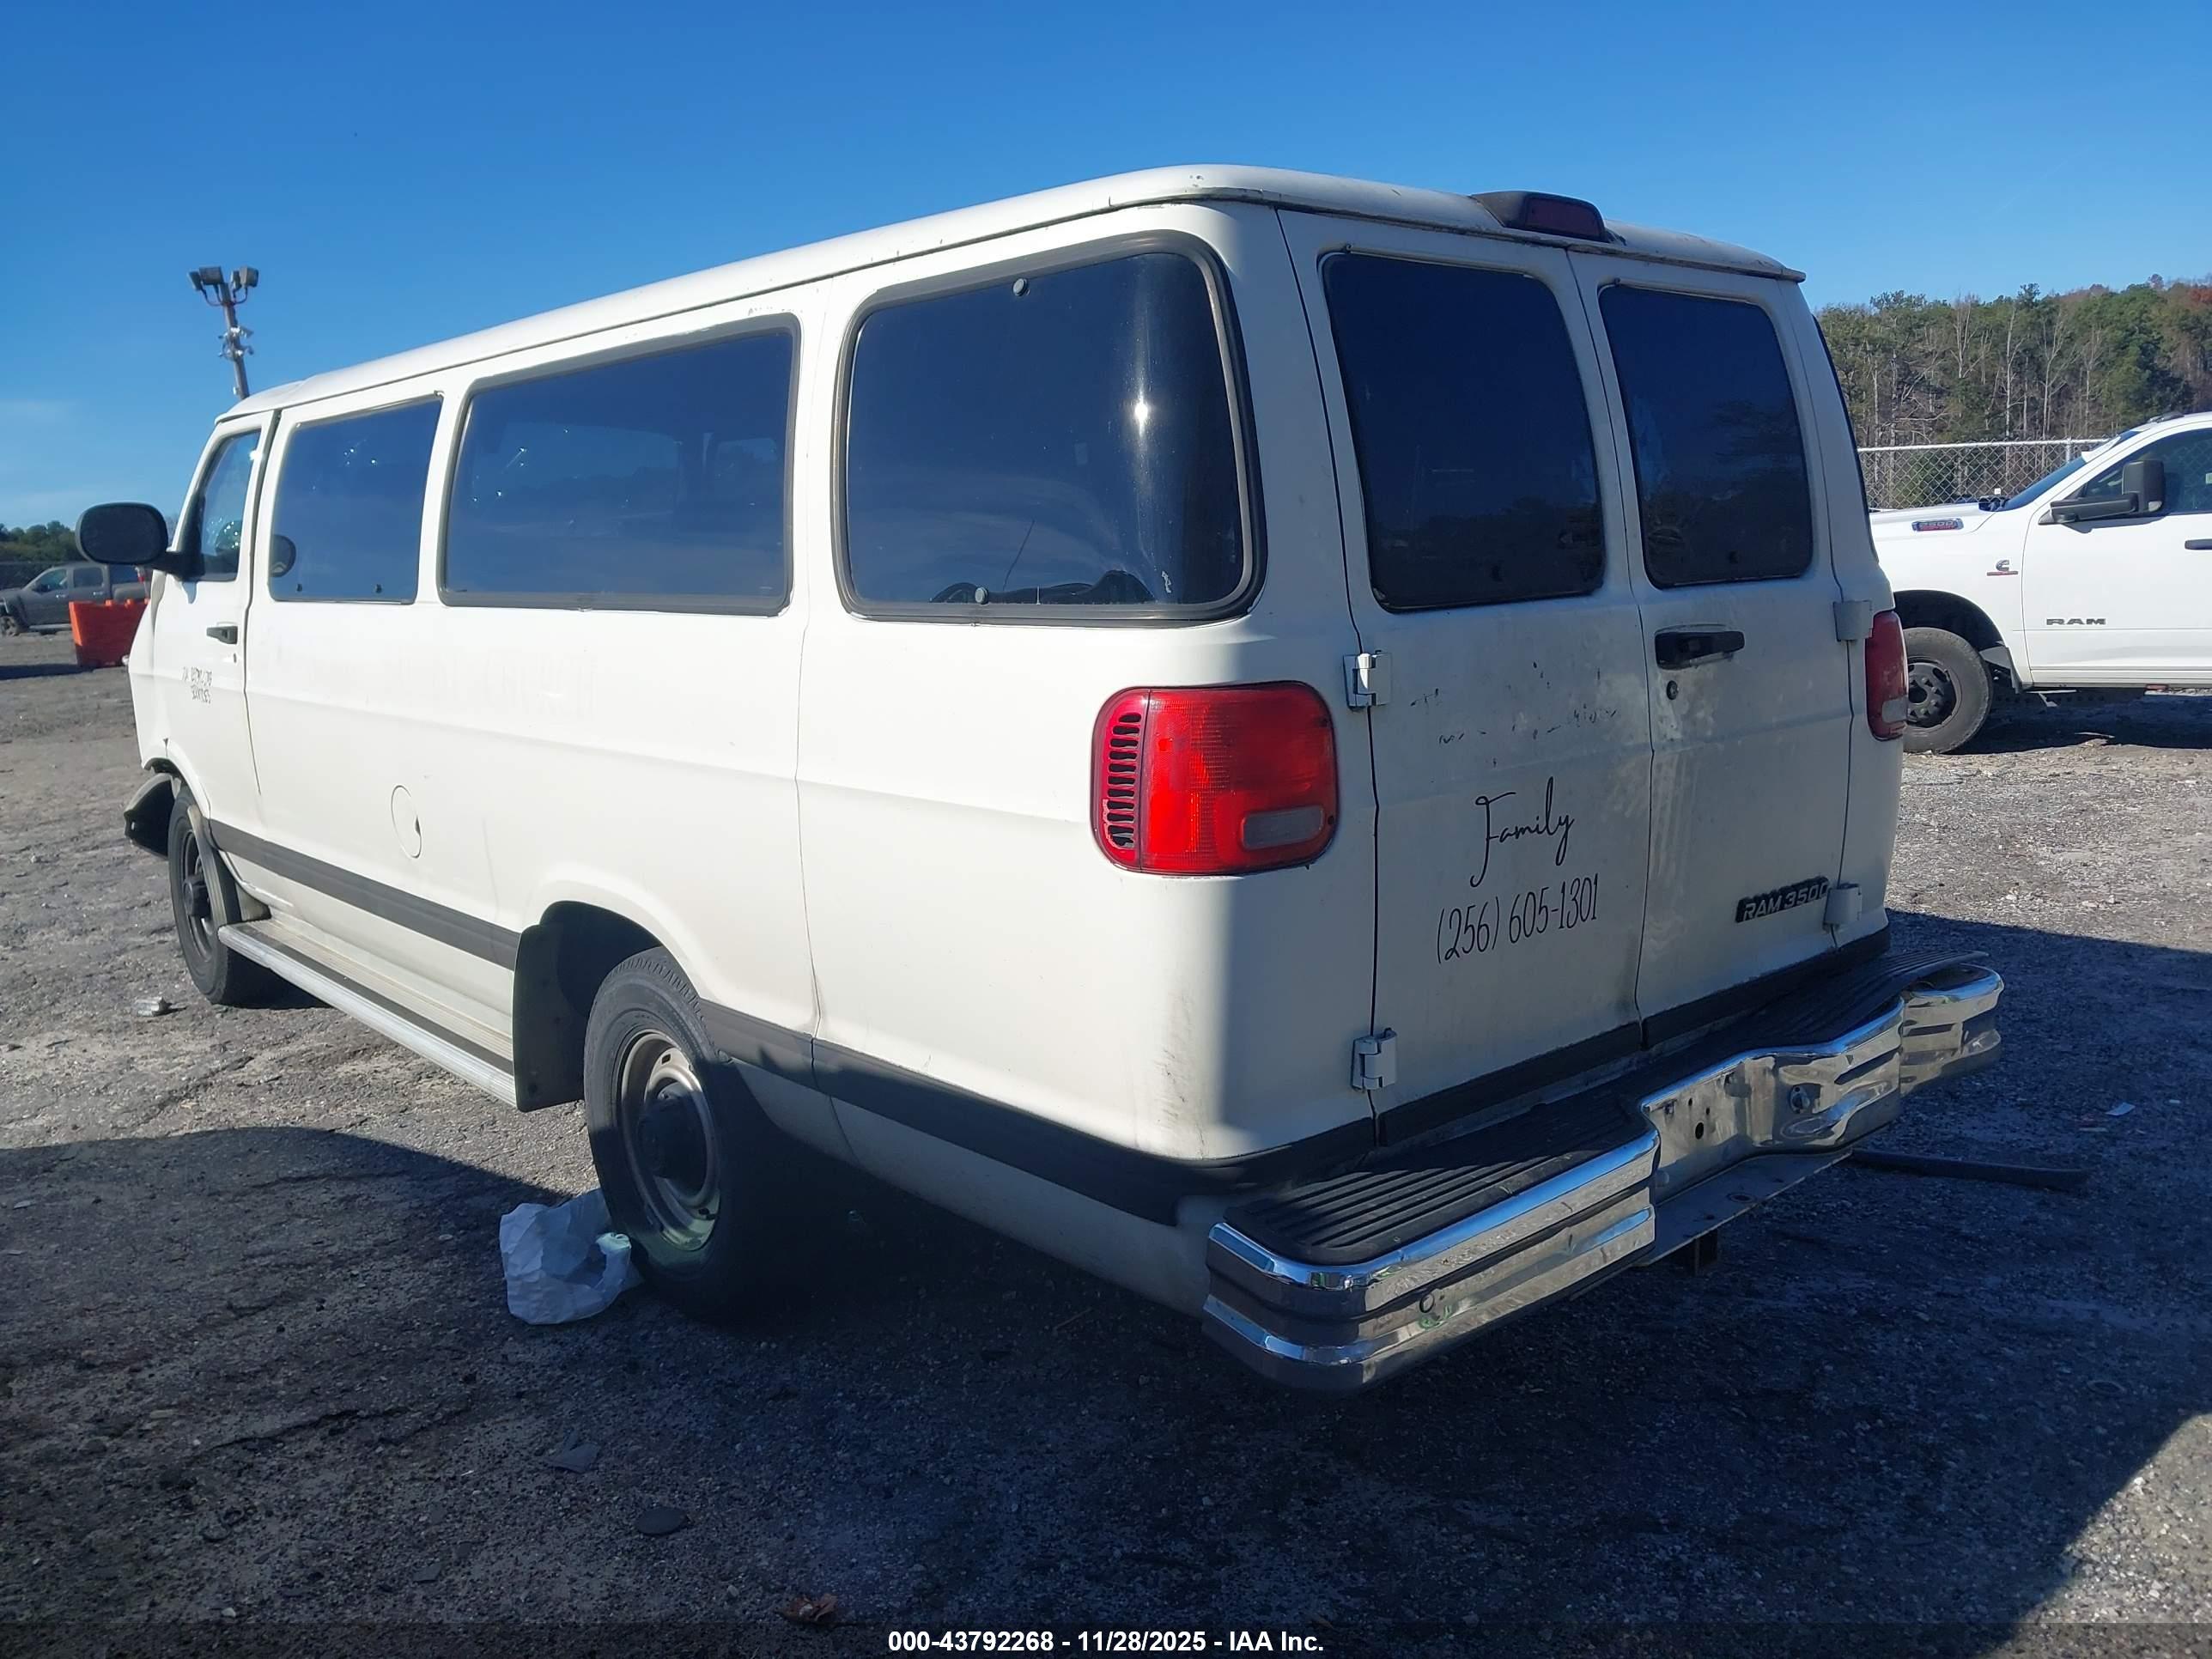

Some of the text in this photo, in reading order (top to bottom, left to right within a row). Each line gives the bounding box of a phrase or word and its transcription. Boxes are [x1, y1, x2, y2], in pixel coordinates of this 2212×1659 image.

[2046, 617, 2106, 626] RAM
[1469, 775, 1575, 888] Family
[1437, 872, 1599, 964] (256) 605-1301
[1743, 894, 1783, 922] RAM
